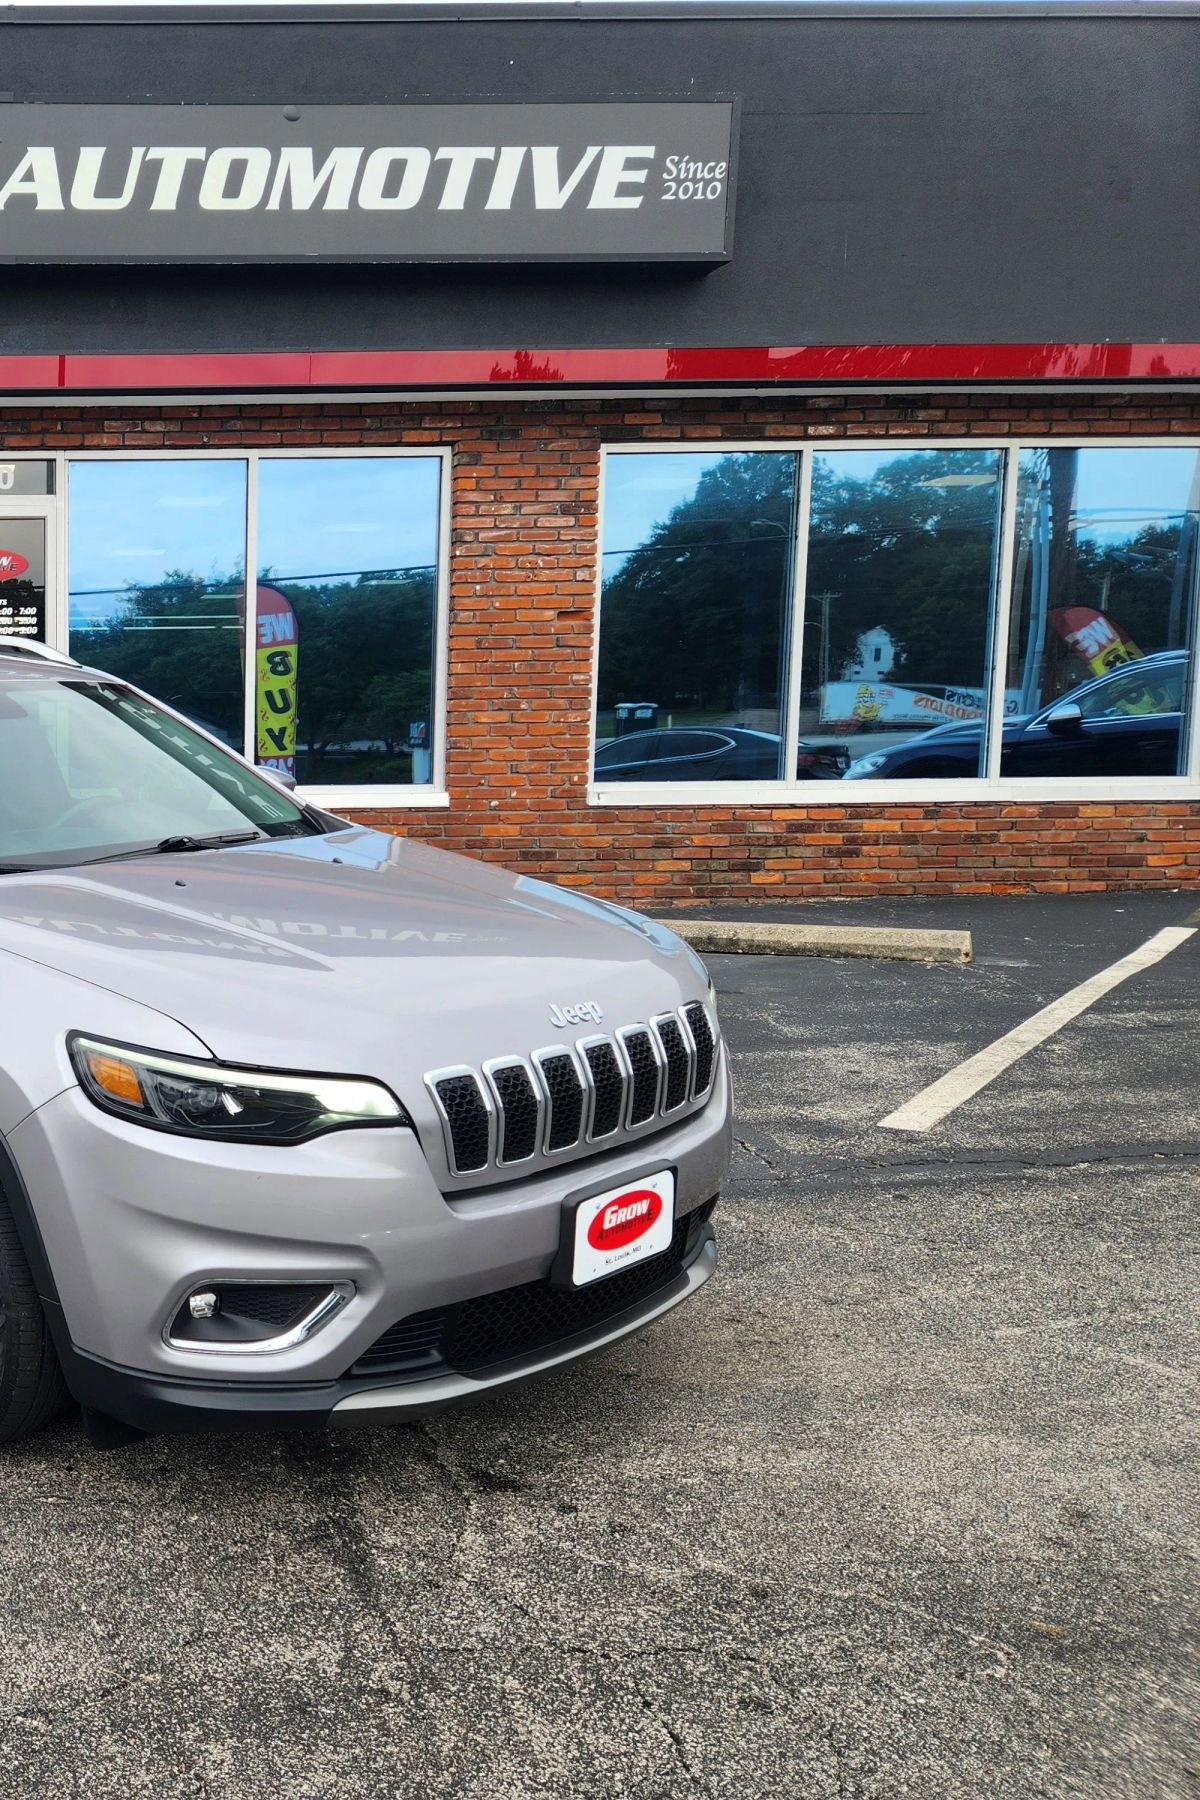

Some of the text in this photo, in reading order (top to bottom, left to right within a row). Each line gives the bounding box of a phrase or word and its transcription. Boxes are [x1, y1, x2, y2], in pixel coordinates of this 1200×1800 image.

[662, 155, 727, 179] Since
[661, 181, 722, 200] 2010
[19, 607, 37, 615] 7:00
[549, 1001, 603, 1029] Jeep
